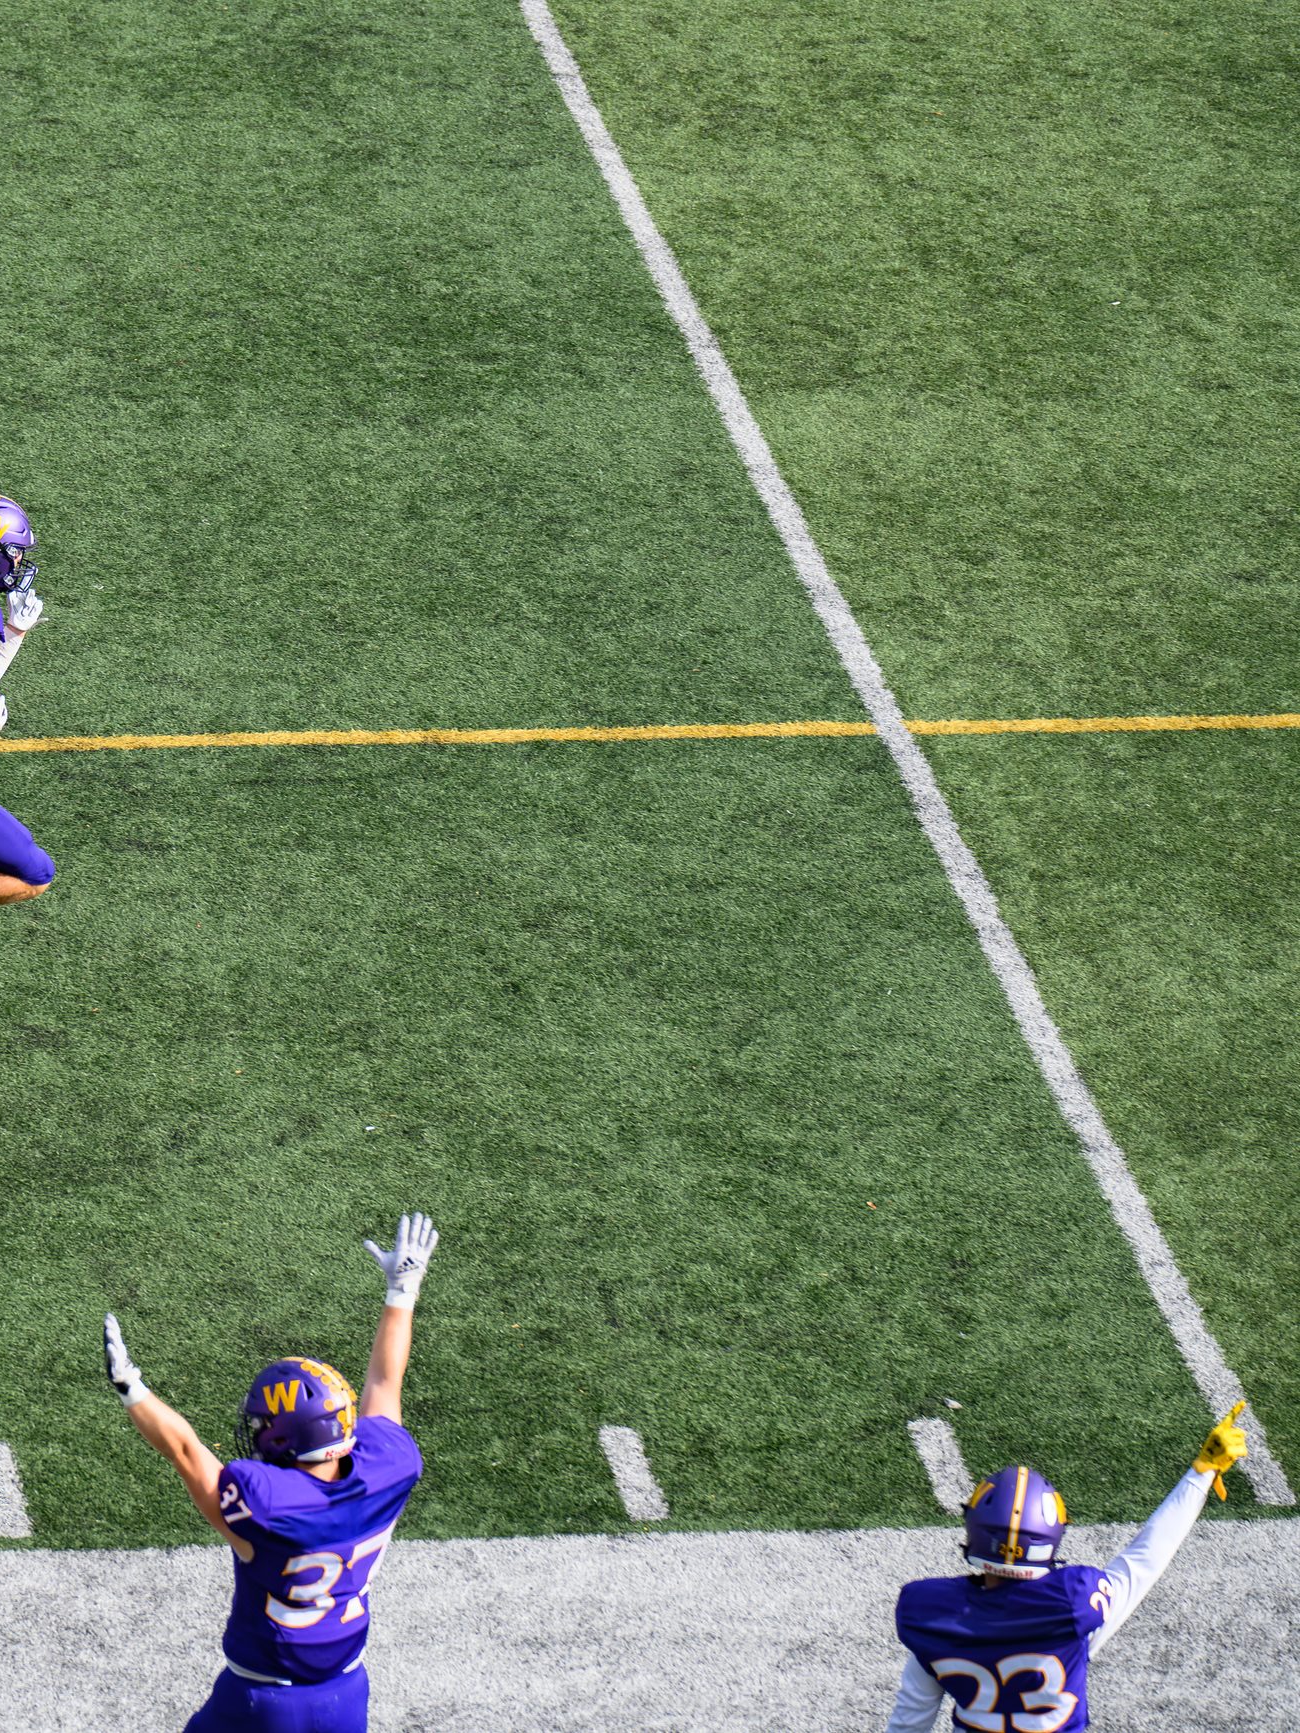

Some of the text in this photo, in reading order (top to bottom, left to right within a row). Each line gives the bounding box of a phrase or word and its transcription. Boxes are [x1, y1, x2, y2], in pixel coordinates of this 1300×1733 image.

[262, 1379, 300, 1416] W
[219, 1482, 253, 1524] 37
[264, 1518, 397, 1629] 37
[929, 1652, 1080, 1733] 23
